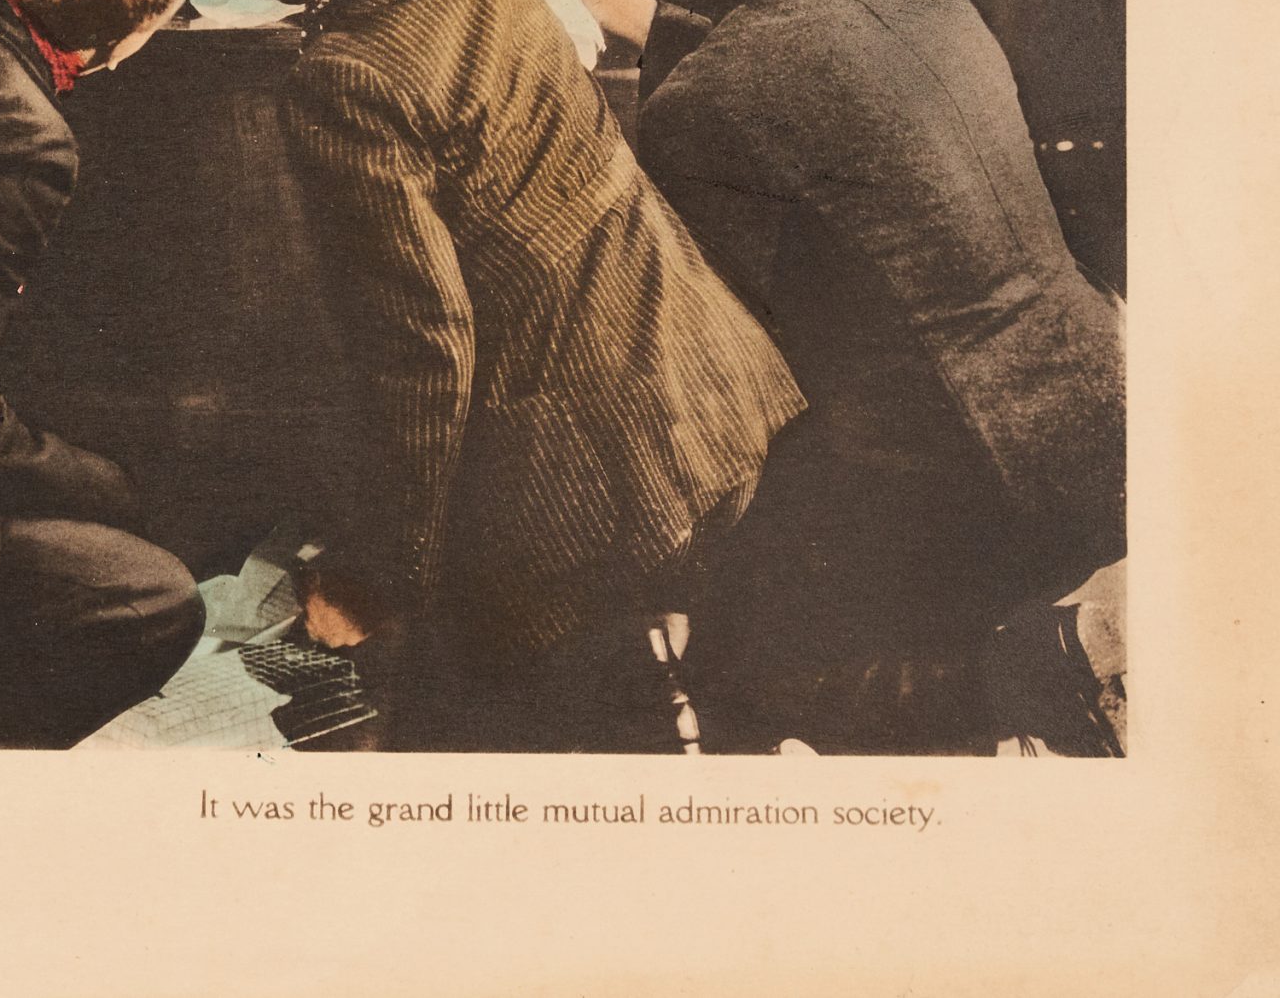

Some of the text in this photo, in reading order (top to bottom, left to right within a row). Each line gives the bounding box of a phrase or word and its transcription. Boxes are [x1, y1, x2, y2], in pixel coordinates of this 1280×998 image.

[200, 790, 944, 833] It was the grand little mutual admiration society.
